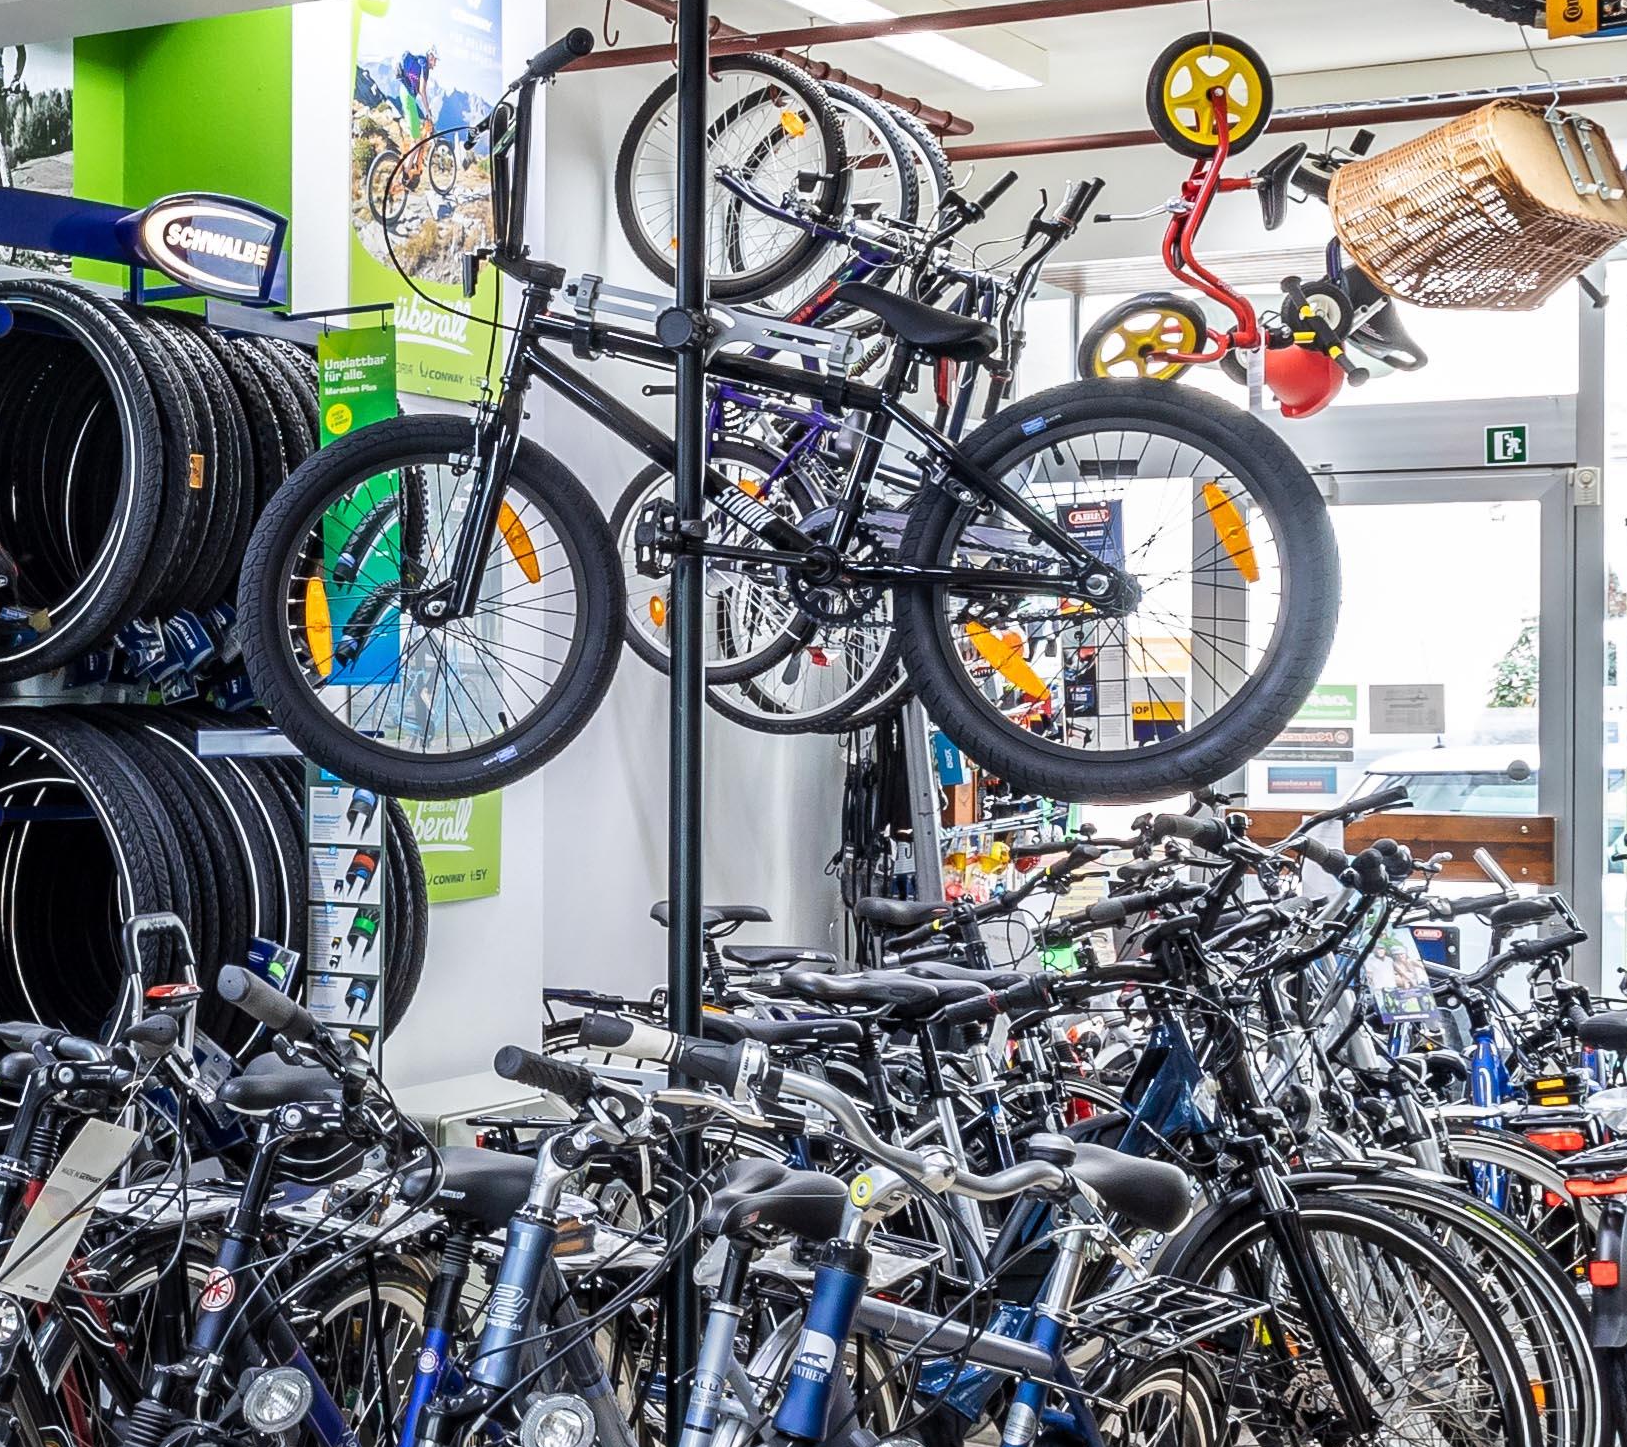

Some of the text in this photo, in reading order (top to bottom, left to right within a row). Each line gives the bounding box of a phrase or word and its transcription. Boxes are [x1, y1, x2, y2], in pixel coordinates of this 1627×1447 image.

[166, 223, 270, 266] SCHWALBE
[394, 295, 469, 346] überall
[323, 355, 387, 372] Unplattbar
[323, 368, 367, 382] für alle.
[428, 368, 465, 385] CONWAY
[324, 383, 379, 396] Marathon Plus
[693, 1379, 721, 1393] ALU
